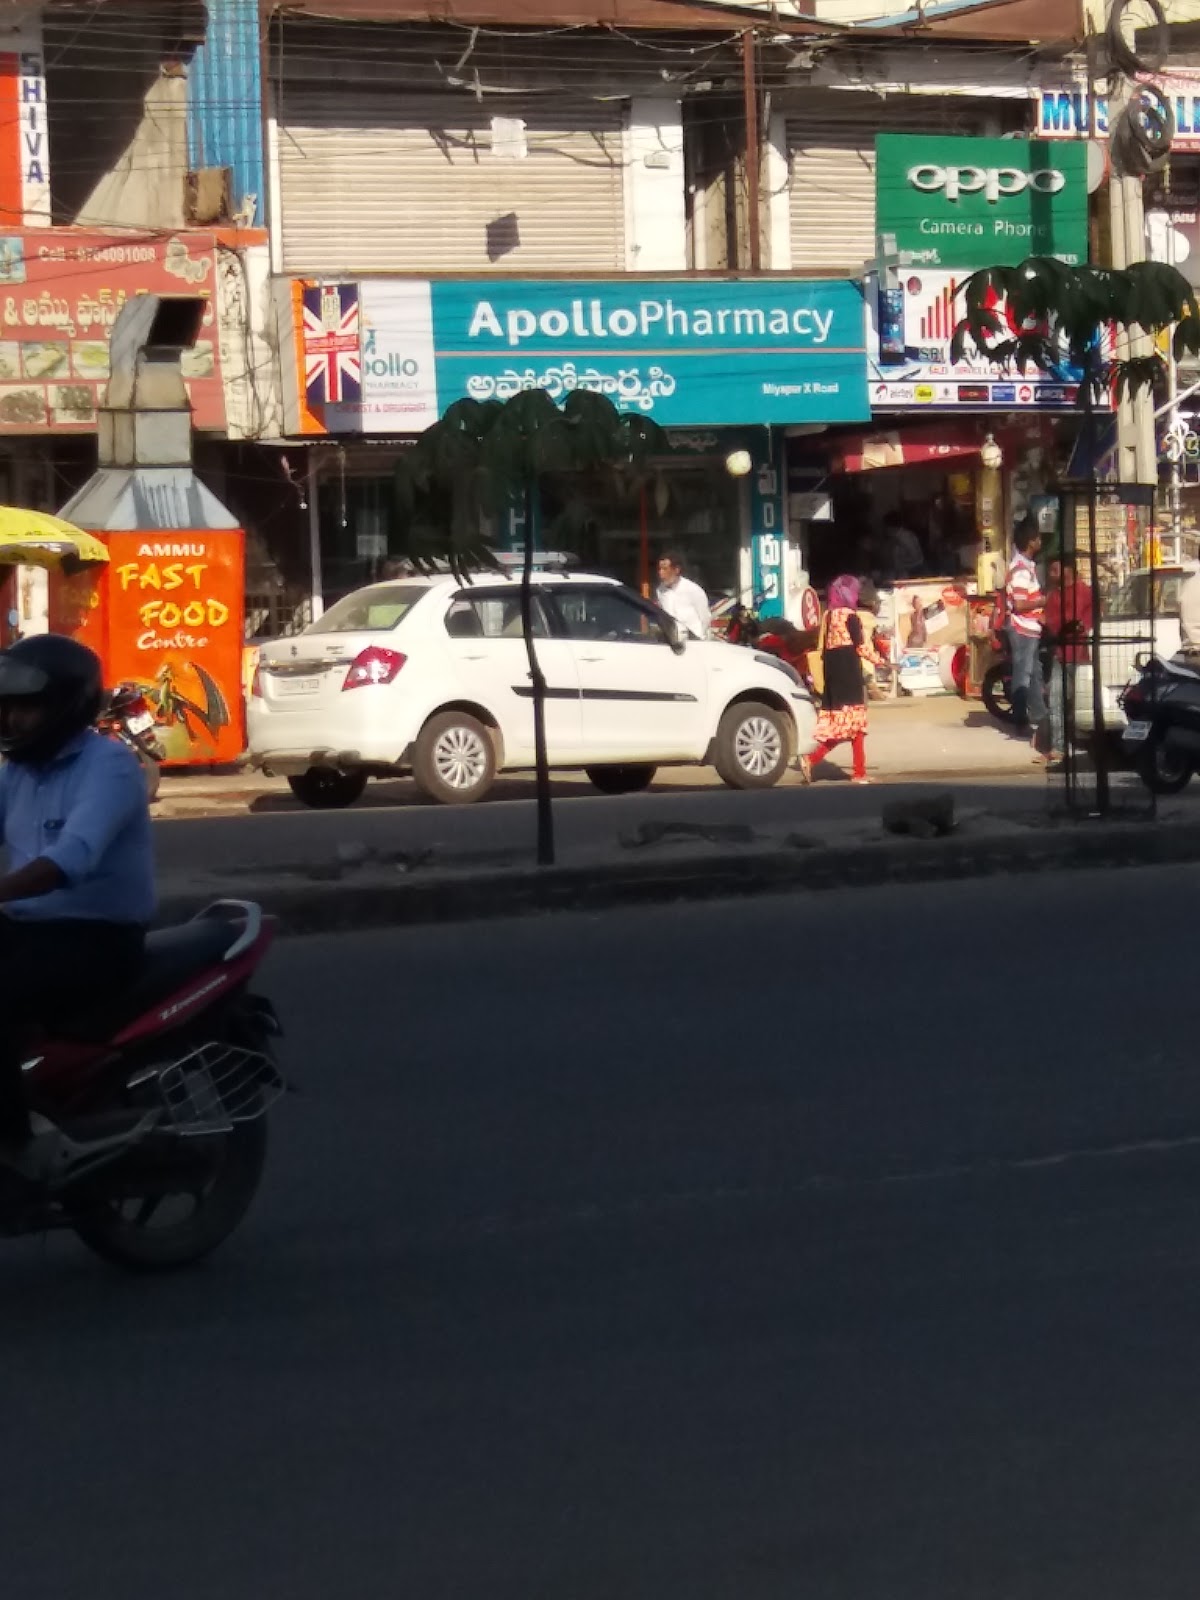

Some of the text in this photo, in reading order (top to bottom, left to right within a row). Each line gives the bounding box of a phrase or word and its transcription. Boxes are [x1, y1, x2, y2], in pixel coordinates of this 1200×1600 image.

[21, 52, 44, 184] SHIVA
[920, 219, 984, 235] Camera
[4, 297, 21, 326] &
[137, 544, 206, 558] AMMU
[116, 563, 208, 591] FAST
[139, 598, 229, 628] FOOD
